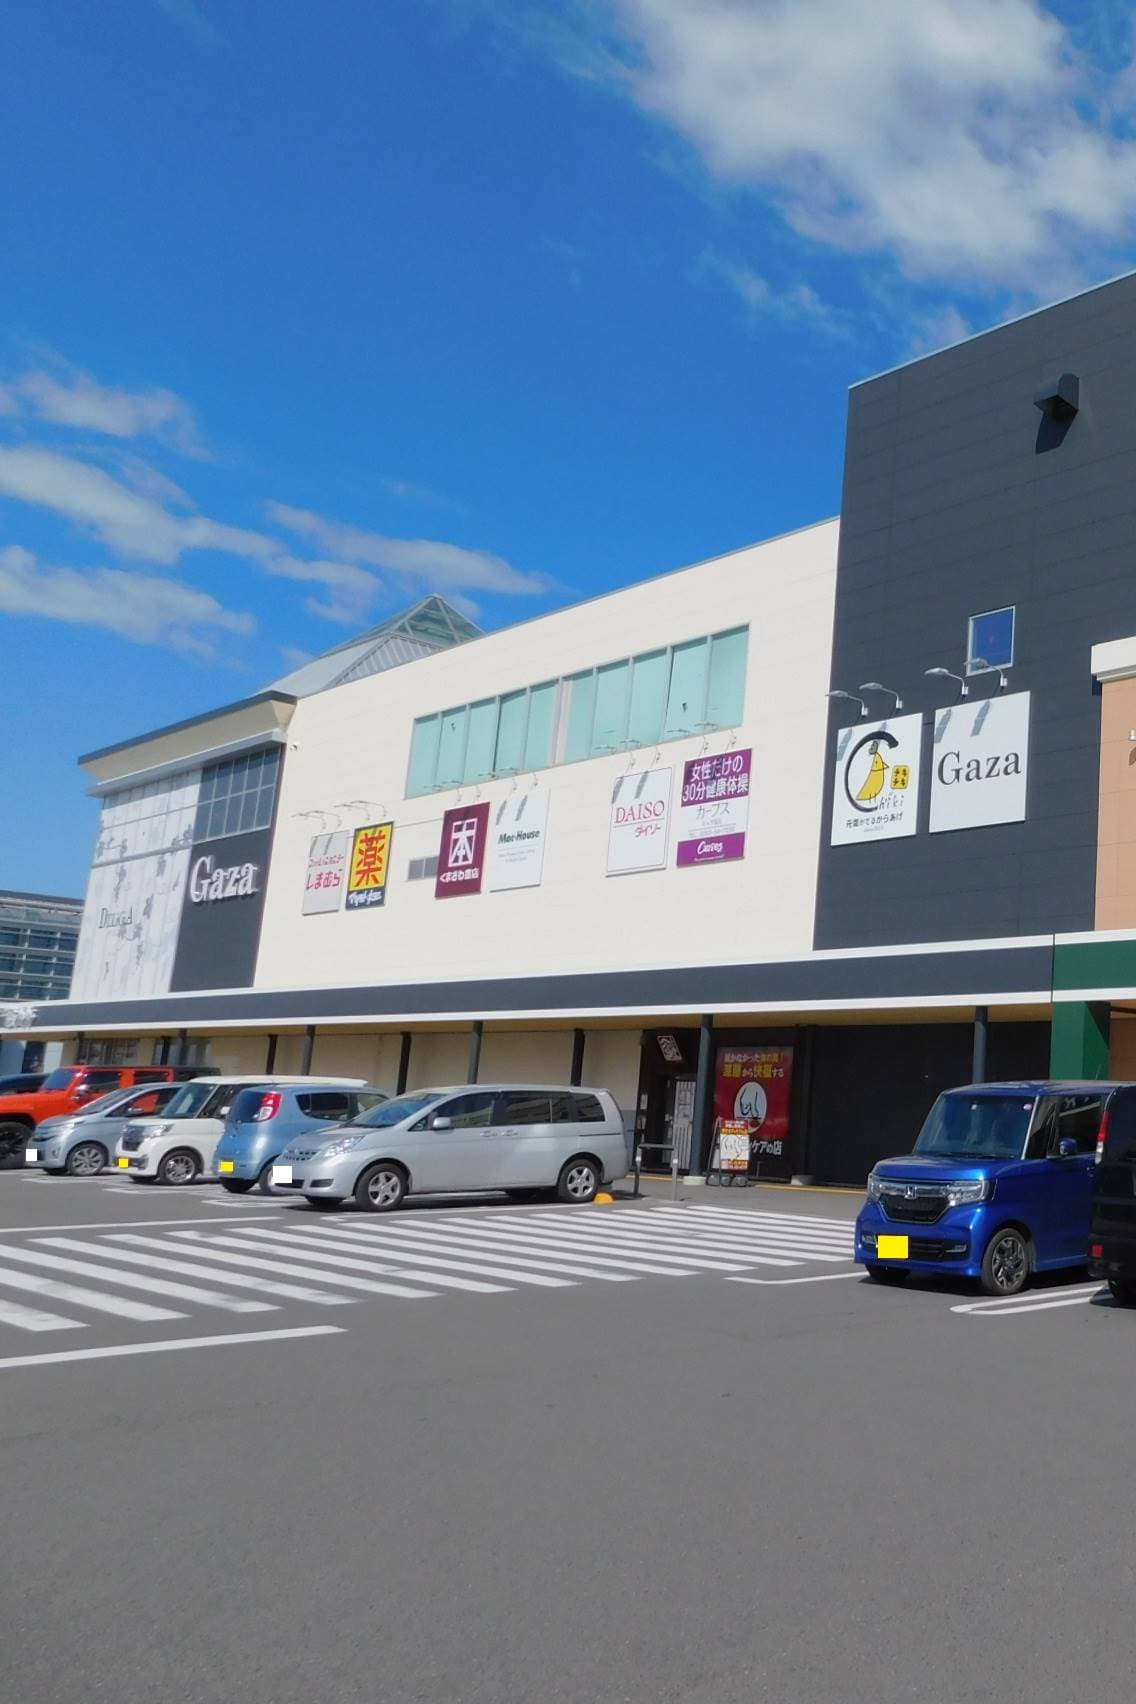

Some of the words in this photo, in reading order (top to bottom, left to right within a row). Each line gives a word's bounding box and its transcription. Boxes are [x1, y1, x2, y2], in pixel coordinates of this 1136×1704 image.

[690, 755, 743, 782] 女性だけの
[937, 750, 1022, 785] Gaza
[615, 800, 665, 823] DAISO
[355, 830, 386, 888] 薬
[190, 855, 259, 903] Gaza
[306, 871, 341, 891] しまむら
